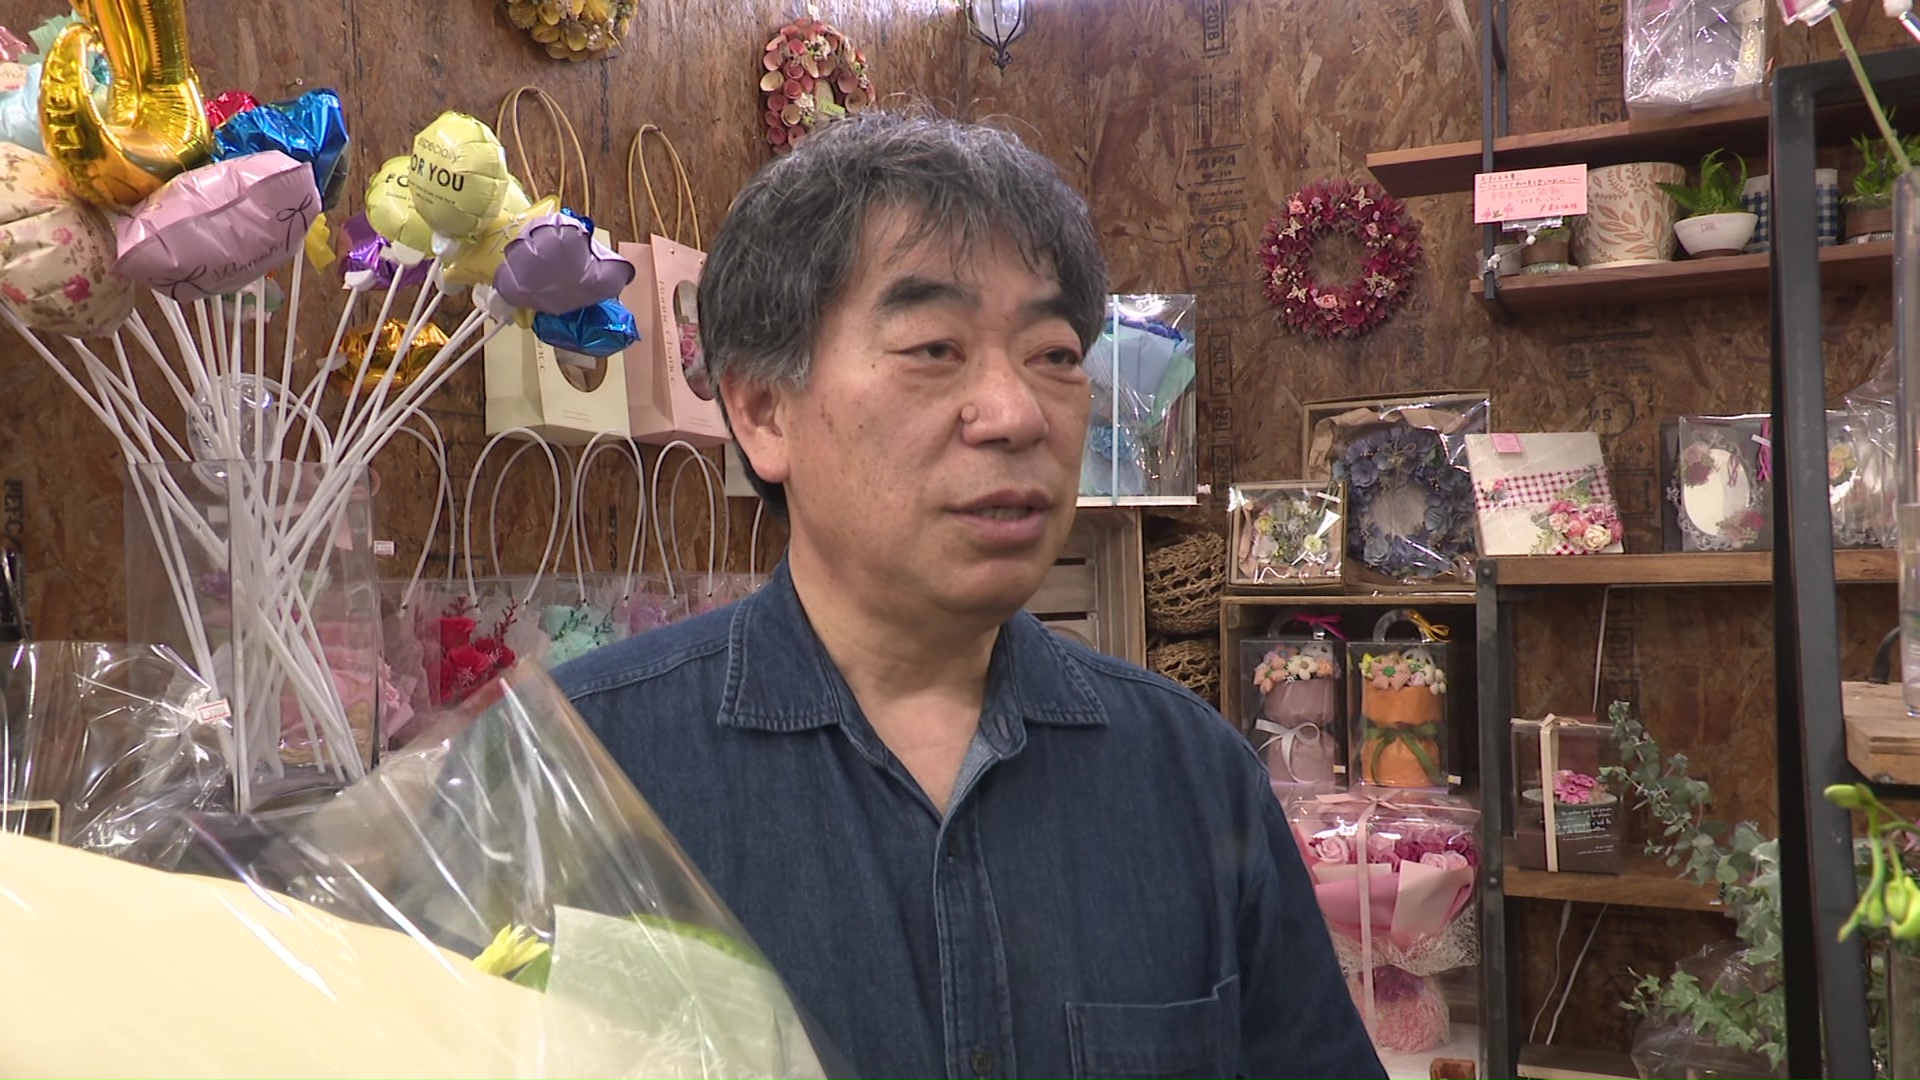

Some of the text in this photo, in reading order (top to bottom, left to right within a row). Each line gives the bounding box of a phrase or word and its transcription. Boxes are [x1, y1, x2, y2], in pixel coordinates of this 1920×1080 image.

[1206, 4, 1220, 40] 2018
[418, 137, 461, 163] especially
[1197, 154, 1236, 170] APA
[385, 172, 409, 188] FO
[411, 154, 464, 192] OR YOU
